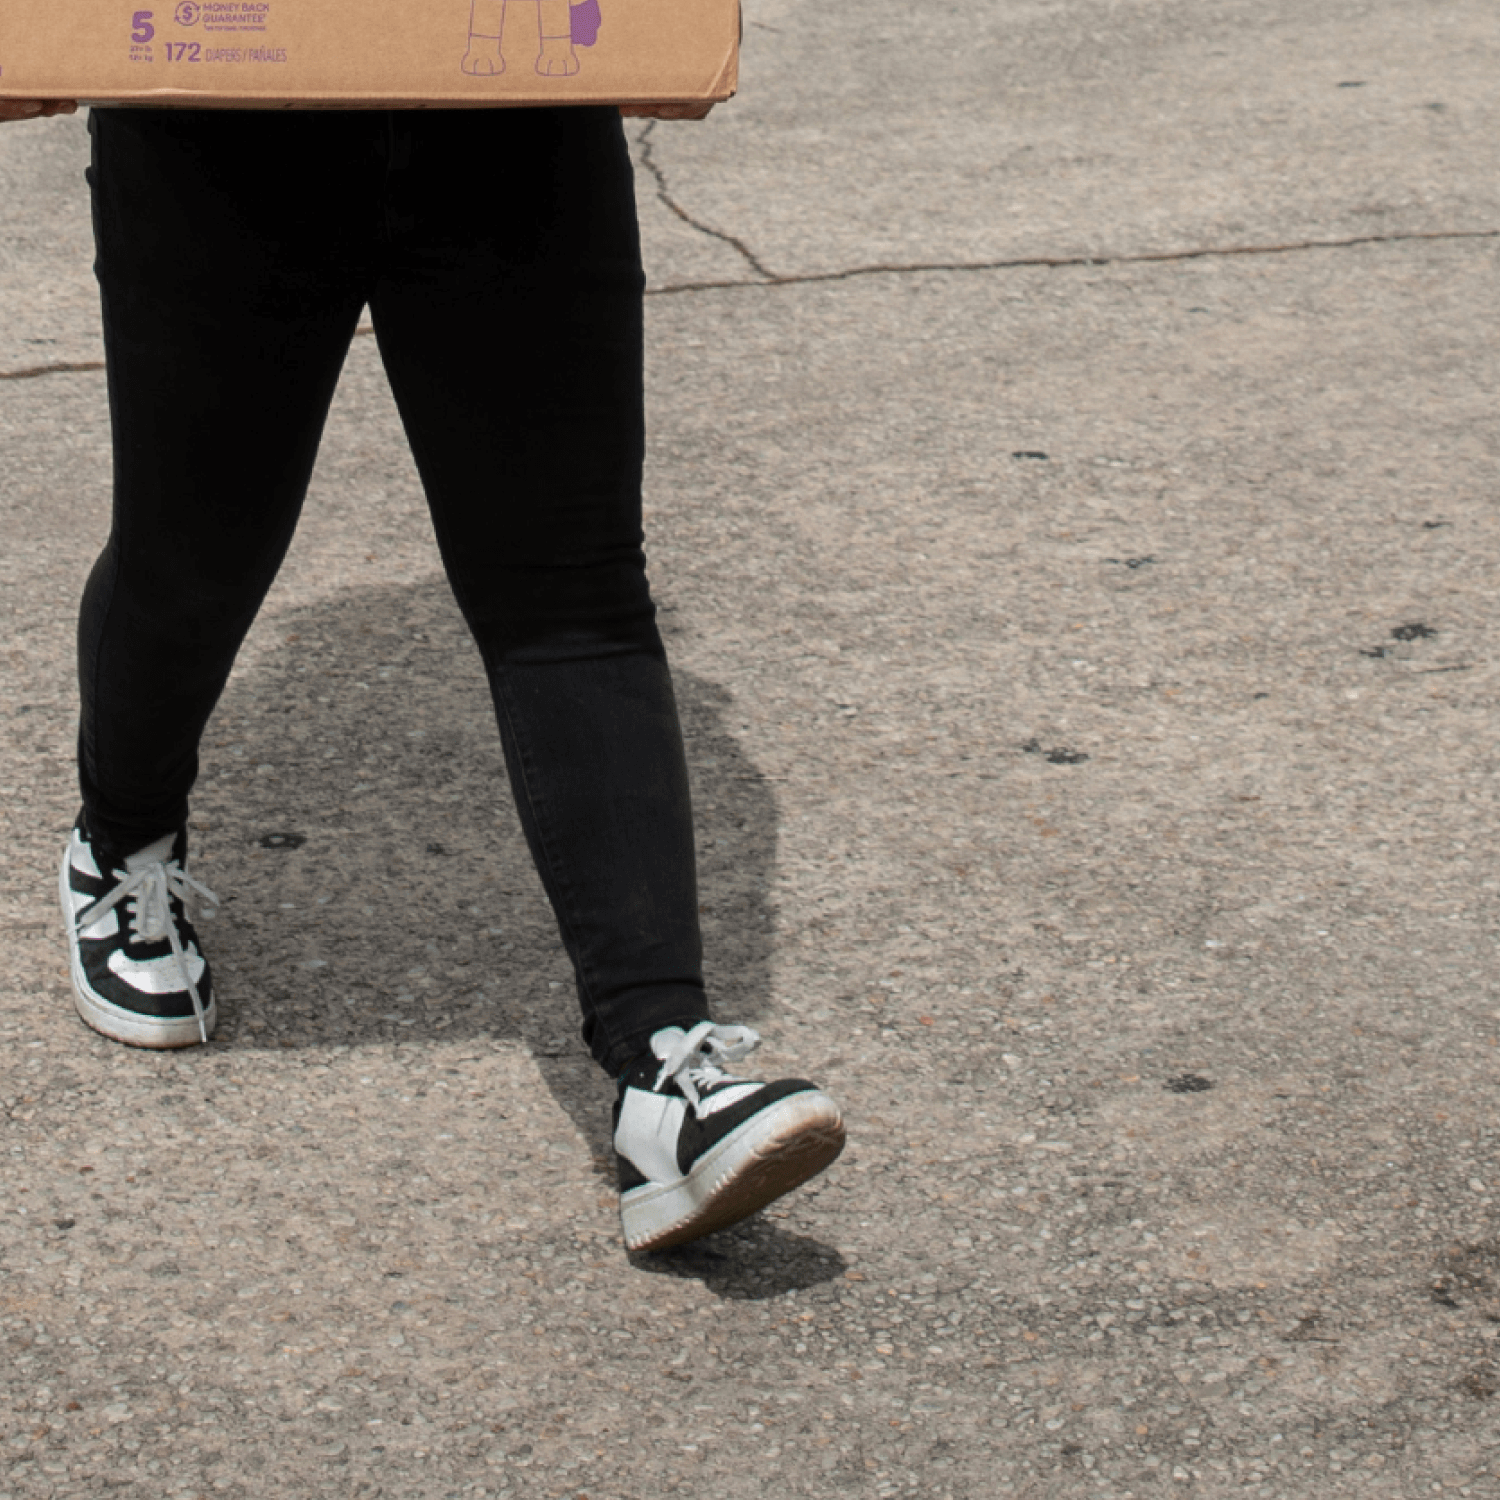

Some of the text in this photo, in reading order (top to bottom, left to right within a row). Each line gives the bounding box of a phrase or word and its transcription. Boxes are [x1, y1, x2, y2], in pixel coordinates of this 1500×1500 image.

[202, 2, 270, 13] MONEY BACK
[131, 10, 155, 44] 5
[164, 41, 202, 63] 172
[205, 47, 241, 63] DIAPERS
[248, 45, 288, 63] PAÑALES
